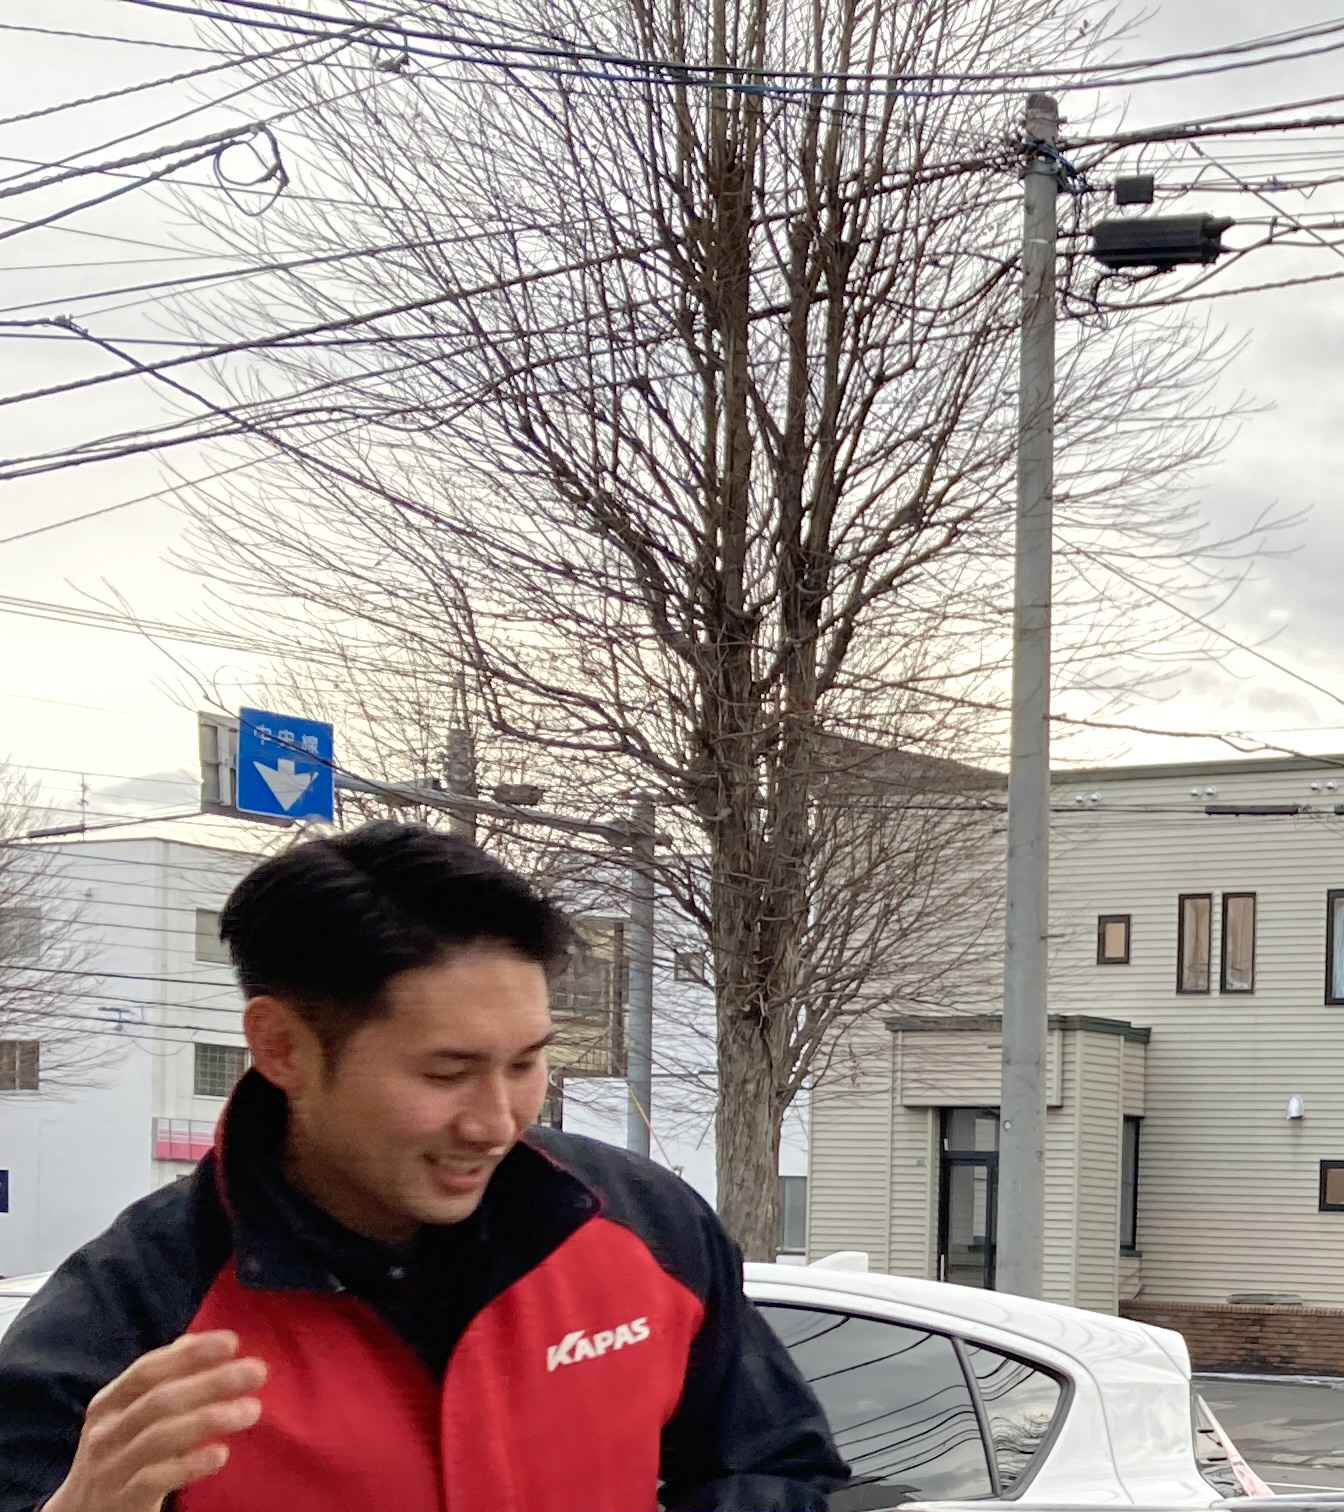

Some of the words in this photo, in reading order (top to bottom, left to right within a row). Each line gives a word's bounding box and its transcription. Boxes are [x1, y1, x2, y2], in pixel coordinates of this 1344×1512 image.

[253, 724, 320, 754] 中央線
[546, 1316, 651, 1372] KAPAS
